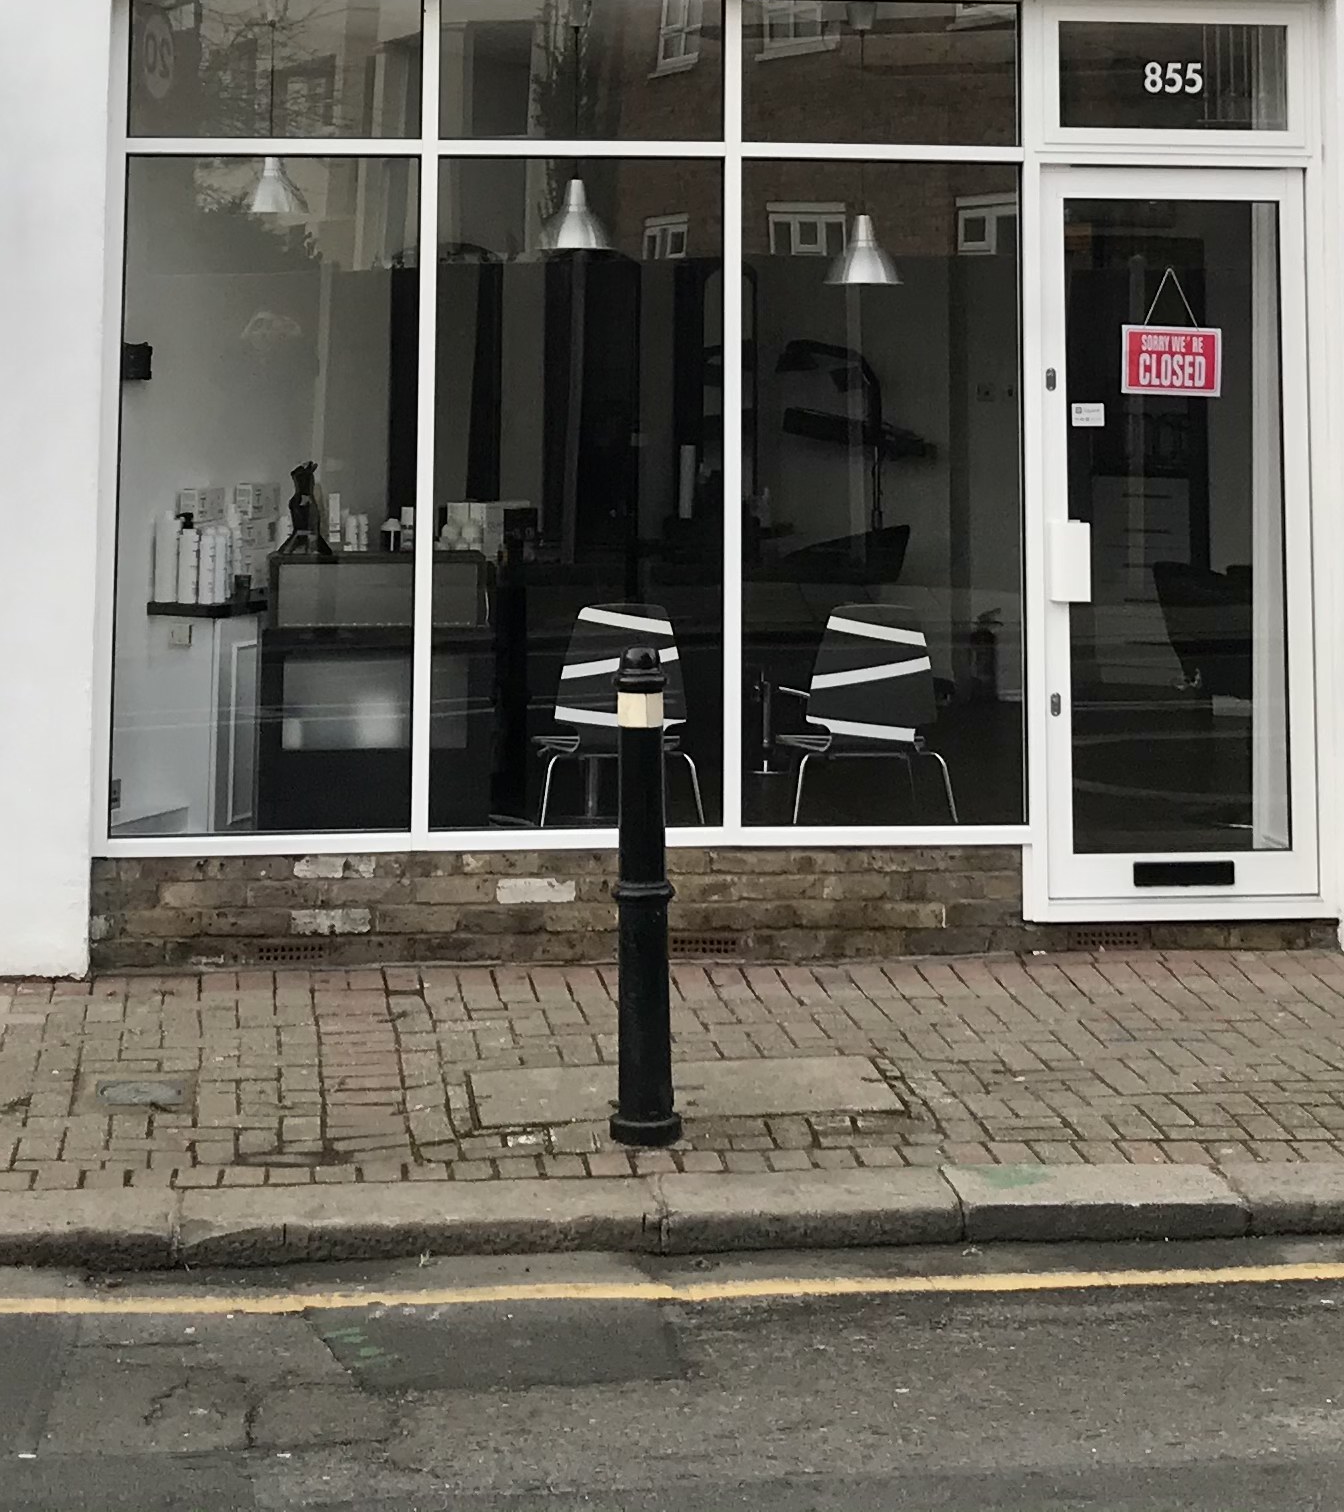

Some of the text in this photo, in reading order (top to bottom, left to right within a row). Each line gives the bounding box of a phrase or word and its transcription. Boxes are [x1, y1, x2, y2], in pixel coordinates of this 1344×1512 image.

[1143, 61, 1203, 94] 855
[1141, 334, 1169, 351] SORRY
[1138, 352, 1206, 388] CLOSED
